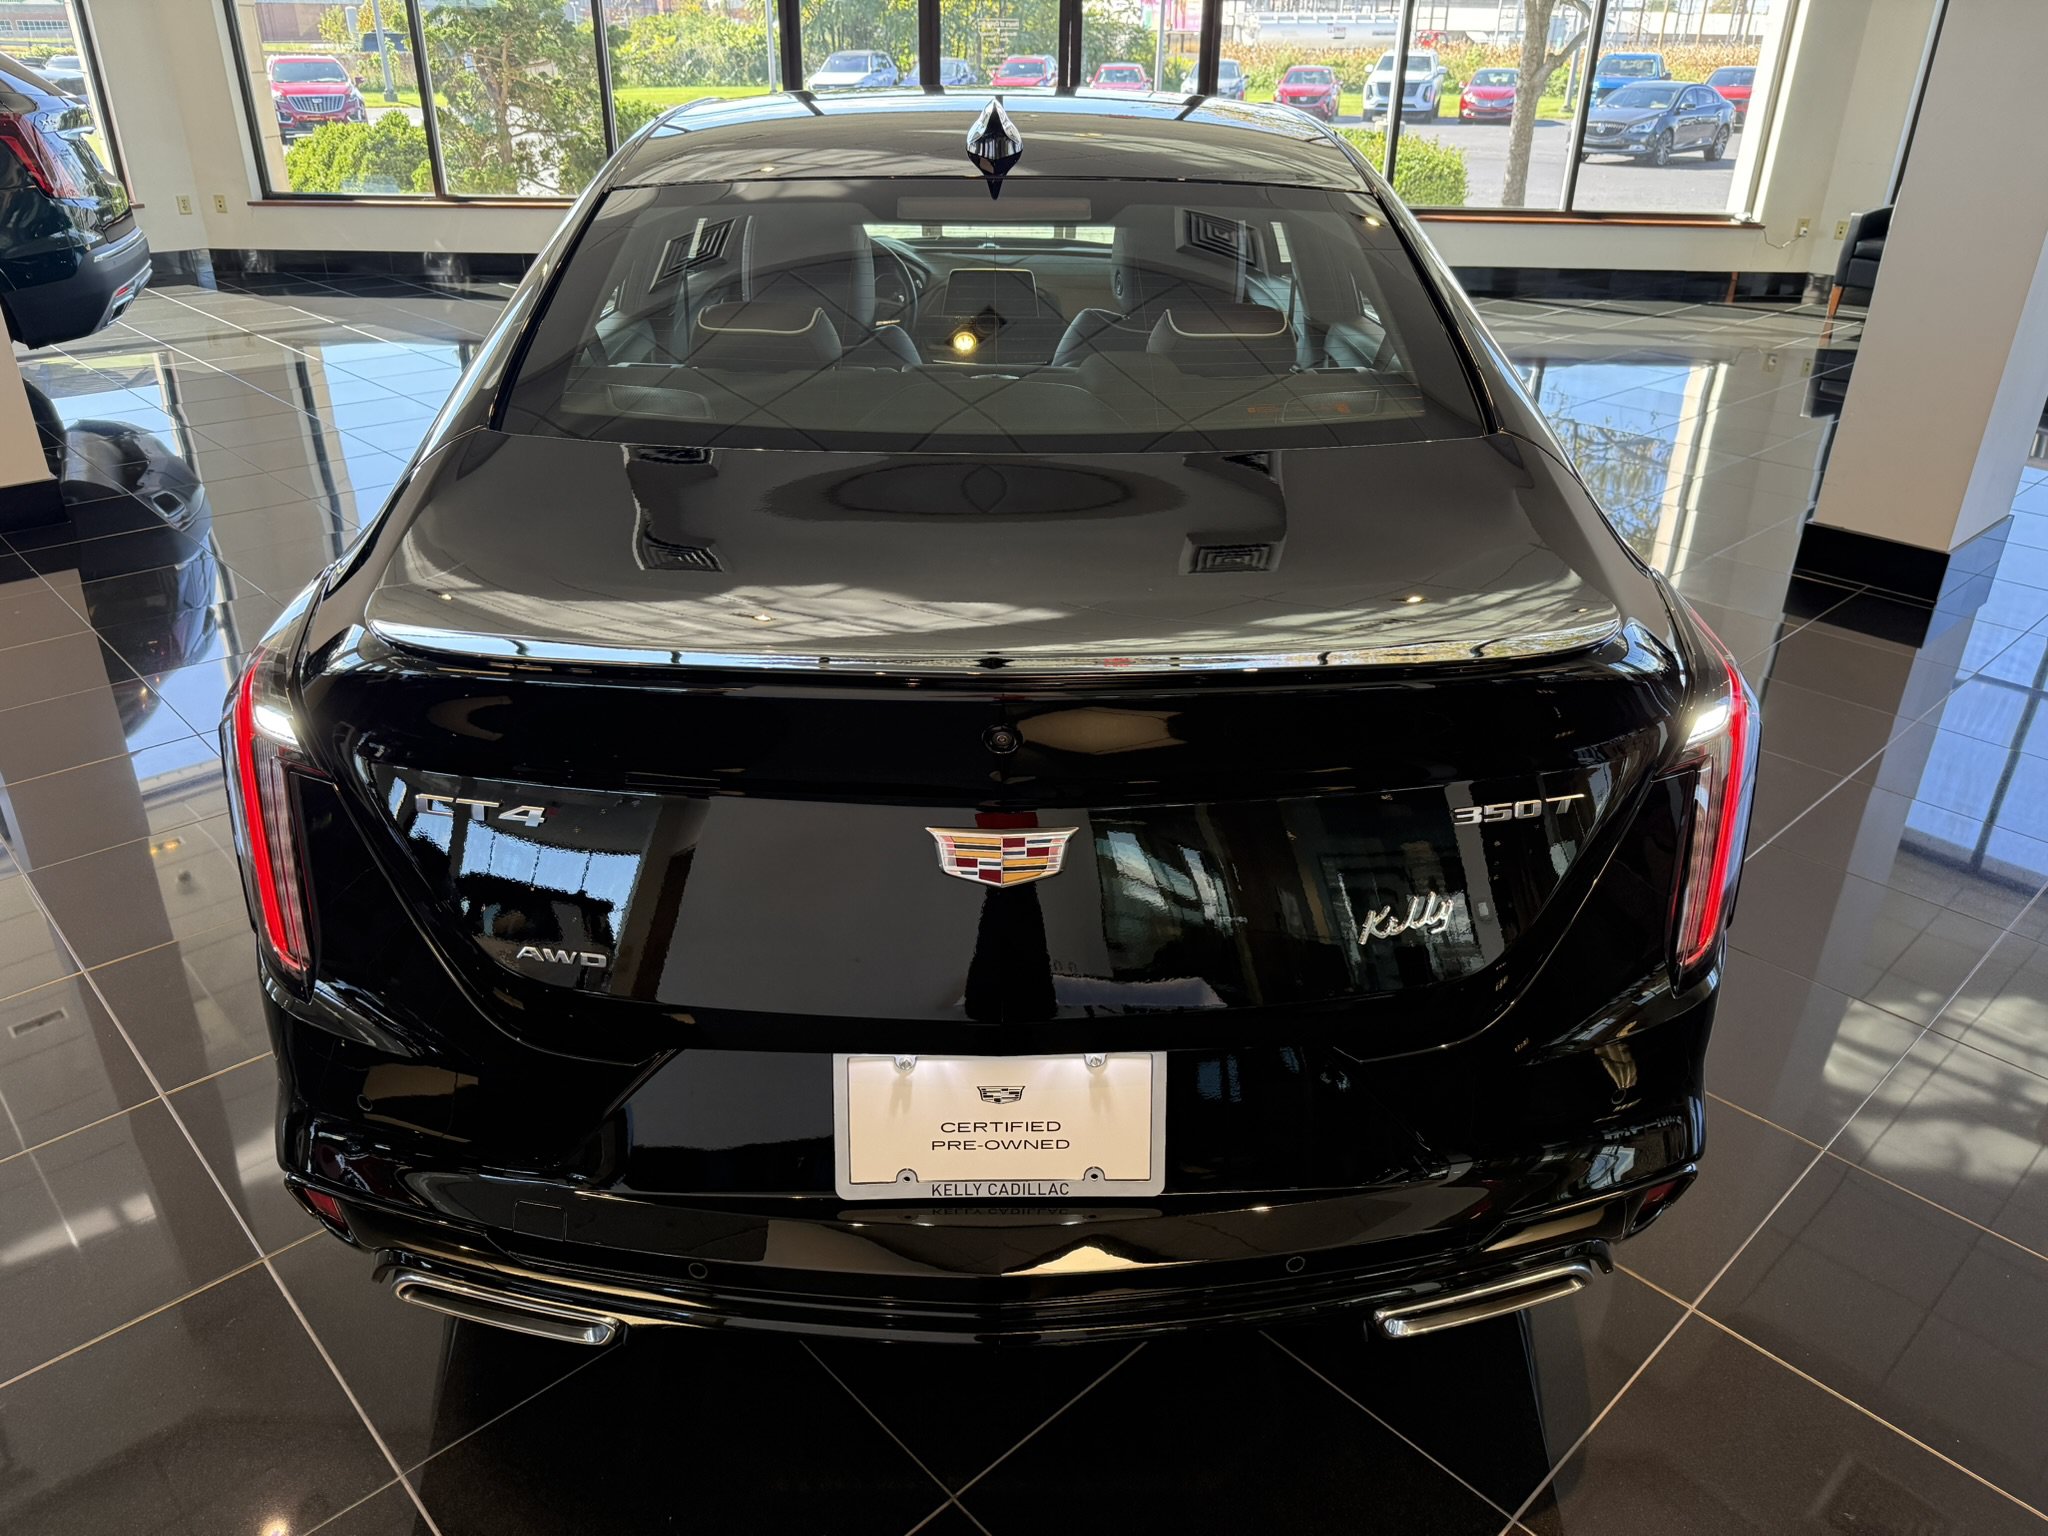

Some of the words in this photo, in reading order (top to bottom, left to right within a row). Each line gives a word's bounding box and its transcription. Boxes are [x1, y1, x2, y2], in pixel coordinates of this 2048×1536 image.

[415, 793, 547, 828] CT4
[1453, 793, 1586, 826] 350T
[1357, 890, 1454, 945] Kelly
[516, 946, 607, 968] AWD
[940, 1120, 1062, 1133] CERTIFIED
[931, 1139, 1070, 1151] PRE-OWNED
[931, 1183, 982, 1197] KELLY
[988, 1182, 1070, 1196] CADILLAC
